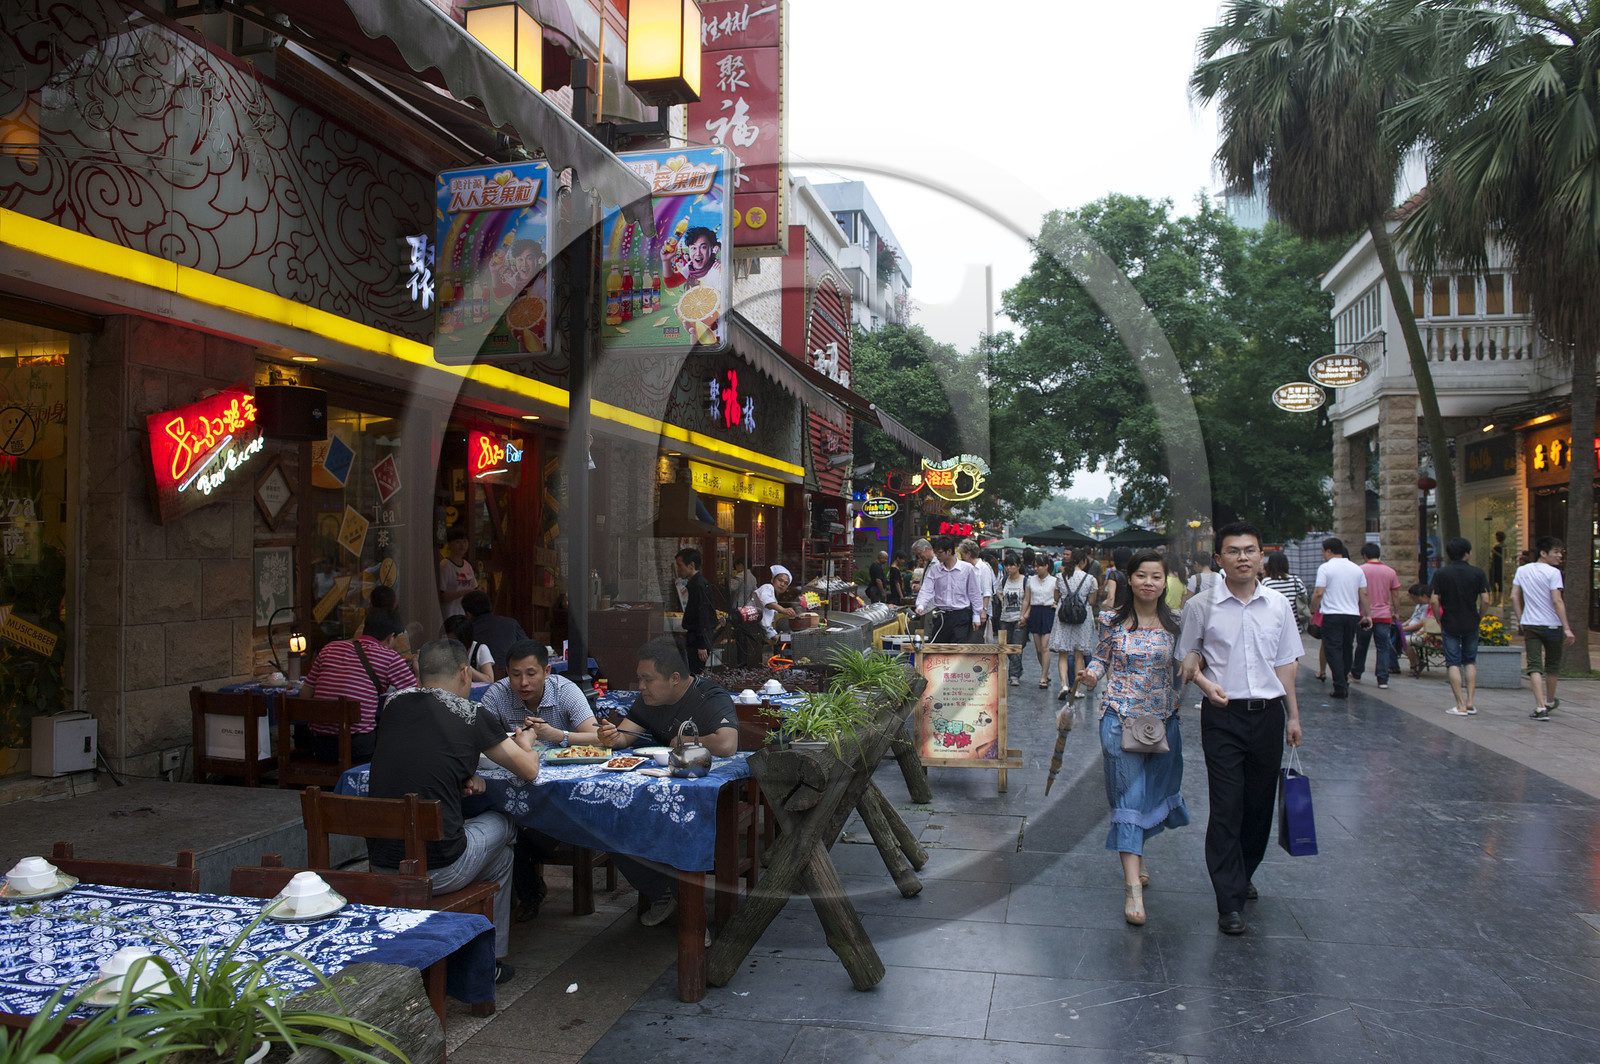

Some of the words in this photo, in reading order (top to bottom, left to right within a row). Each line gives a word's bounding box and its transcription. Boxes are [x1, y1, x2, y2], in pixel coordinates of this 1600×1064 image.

[629, 163, 654, 175] 汁源
[642, 171, 707, 192] 爱果粒
[451, 185, 533, 209] 人人爱果粒
[709, 369, 756, 434] 聚福林
[506, 443, 523, 463] Bar
[372, 505, 395, 524] Tea
[864, 503, 879, 511] Irish
[883, 503, 896, 511] Pub
[377, 529, 389, 547] 茶
[939, 522, 973, 536] BAR
[6, 618, 55, 647] MUSIC&BEER
